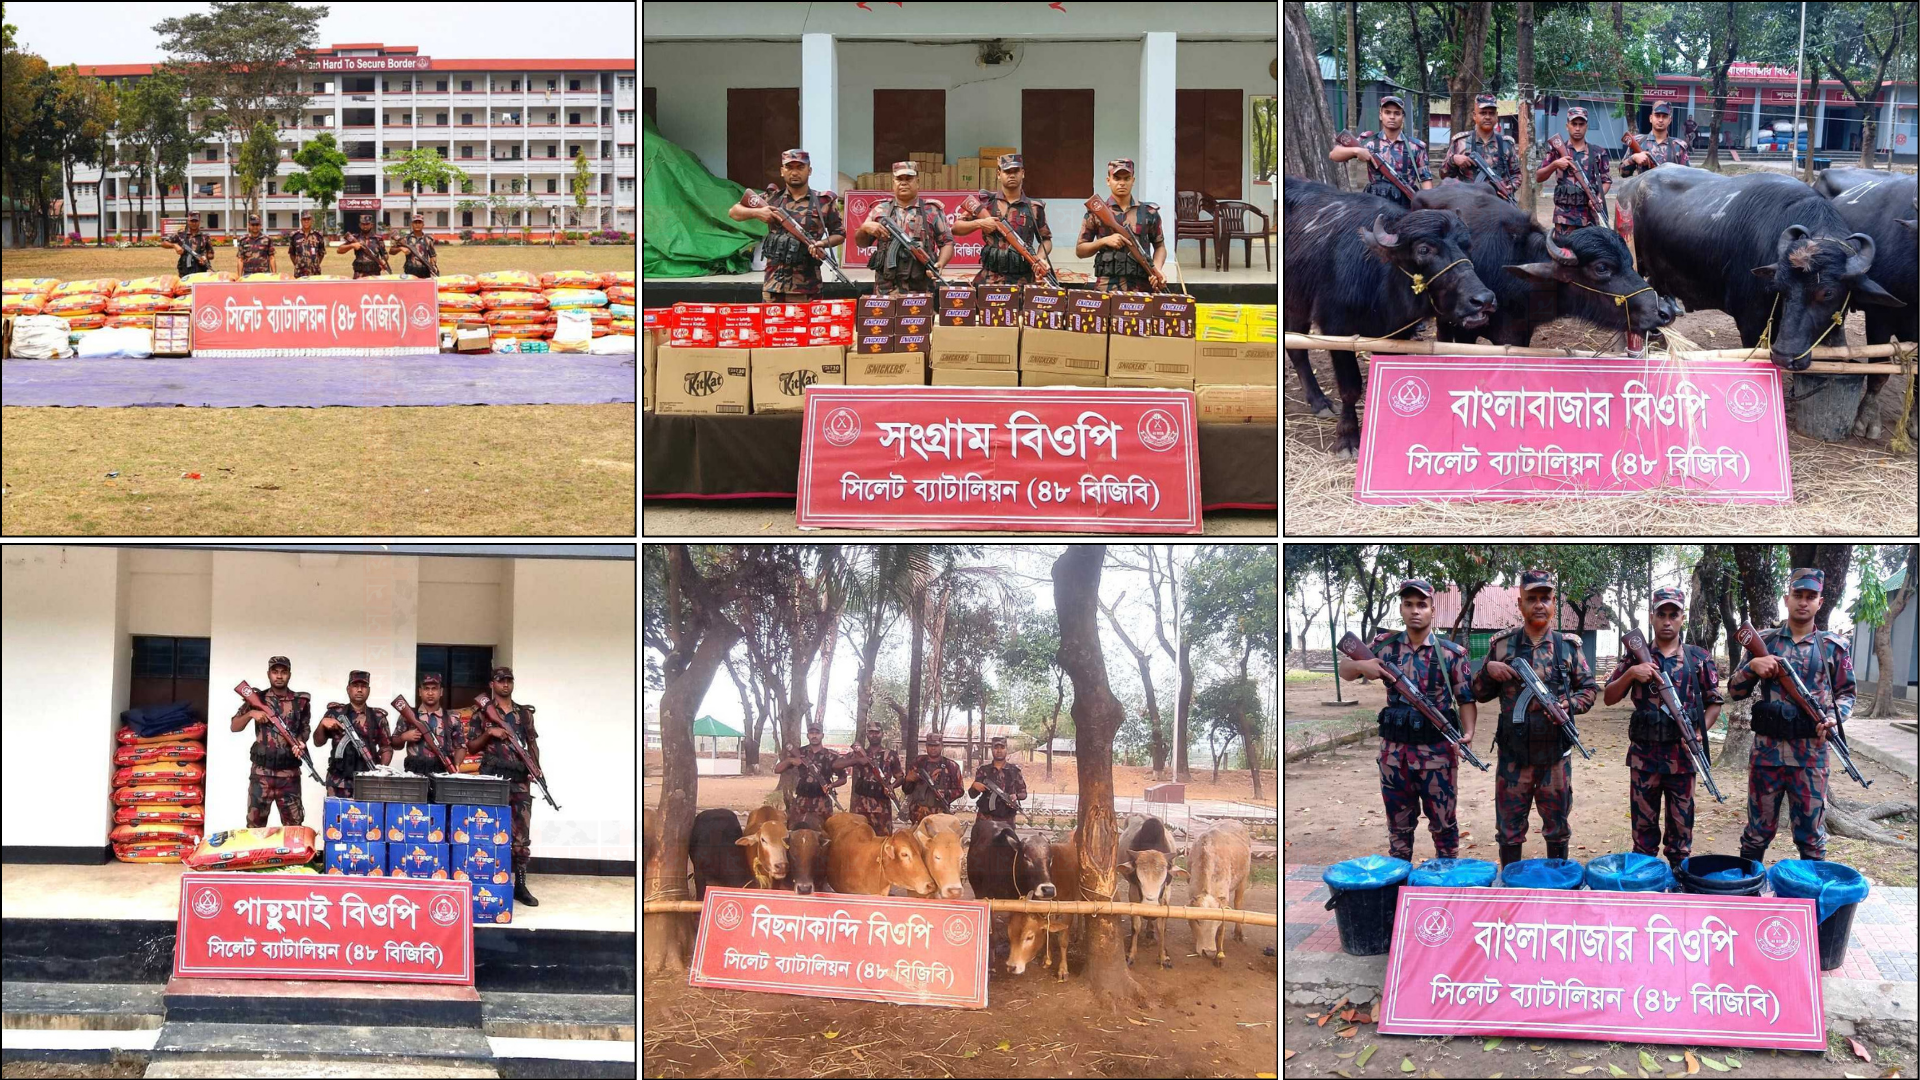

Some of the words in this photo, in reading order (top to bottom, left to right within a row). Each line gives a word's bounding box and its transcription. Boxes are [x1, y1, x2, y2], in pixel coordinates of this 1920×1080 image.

[323, 59, 342, 69] Hard
[345, 59, 355, 69] To
[357, 58, 385, 69] Secure
[388, 58, 415, 69] Border
[225, 296, 265, 333] সিলেট
[266, 295, 328, 333] ব্যাটালিয়ন
[331, 300, 357, 339] (৪৮
[360, 294, 407, 339] বিজিবি)
[689, 371, 721, 396] KitKat
[784, 370, 816, 396] KitKat
[864, 364, 906, 374] SNICKERS
[1448, 386, 1614, 431] বাংলাবাজার
[1620, 379, 1711, 431] বিওপি
[875, 417, 997, 461] সংগ্রাম
[1005, 410, 1123, 460] বিওপি
[1406, 443, 1481, 477] সিলেট
[1488, 444, 1604, 477] ব্যাটালিয়ন
[1611, 450, 1658, 482] (৪৮
[1666, 446, 1751, 483] বিজিবি)
[840, 471, 907, 502] সিলেট
[912, 472, 1020, 503] ব্যাটালিয়ন
[1027, 477, 1071, 509] (৪৮
[1078, 474, 1160, 512] বিজিবি)
[339, 892, 420, 931] বিওপি
[751, 904, 862, 946] বিছনাকান্দি
[867, 911, 934, 950] বিওপি
[207, 935, 257, 958] সিলেট
[261, 937, 339, 960] ব্যাটালিয়ন
[345, 941, 379, 965] (৪৮
[384, 940, 444, 969] বিজিবি)
[1472, 916, 1637, 964] বাংলাবাজার
[1644, 913, 1739, 967] বিওপি
[724, 947, 771, 971] সিলেট
[775, 953, 851, 978] ব্যাটালিয়ন
[856, 960, 887, 984] (৪৮
[894, 958, 954, 990] বিজিবি)
[1429, 973, 1503, 1006] সিলেট
[1508, 977, 1626, 1013] ব্যাটালিয়ন
[1633, 984, 1681, 1020] (৪৮
[1689, 982, 1781, 1026] বিজিবি)
